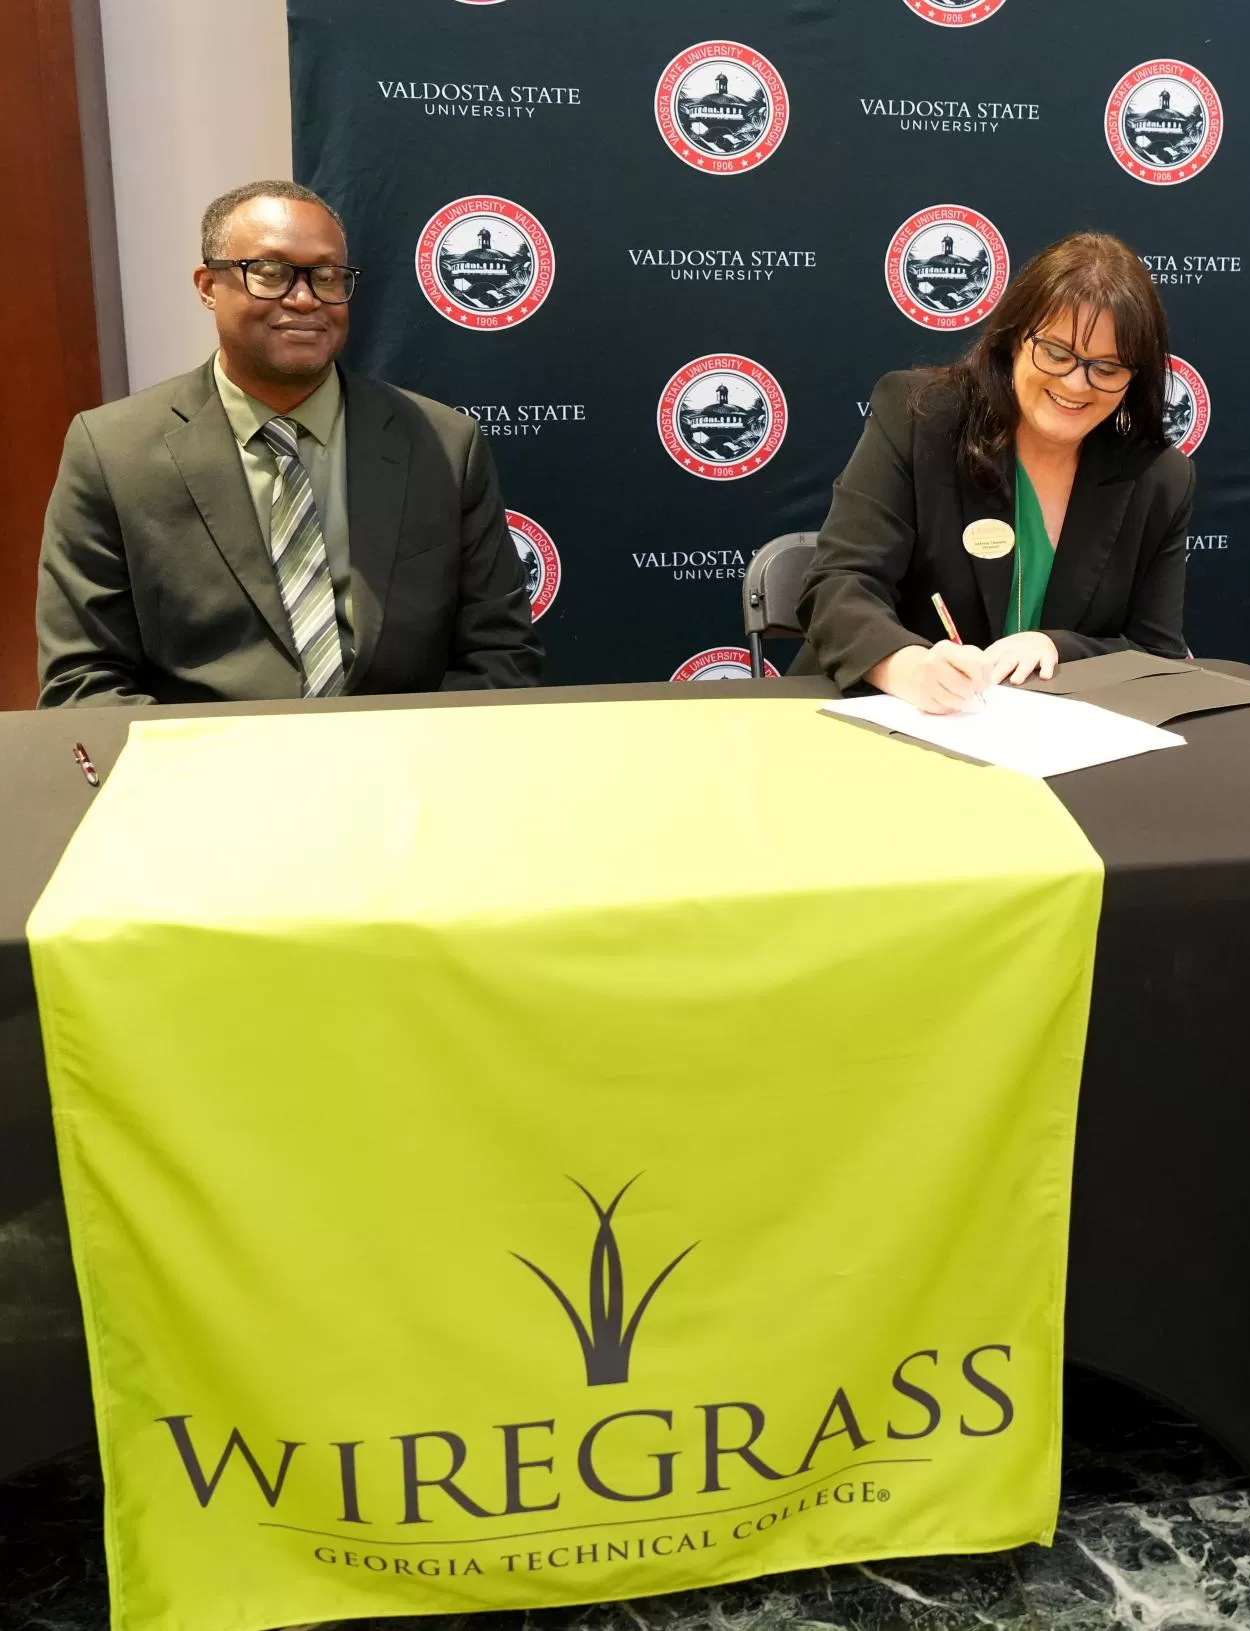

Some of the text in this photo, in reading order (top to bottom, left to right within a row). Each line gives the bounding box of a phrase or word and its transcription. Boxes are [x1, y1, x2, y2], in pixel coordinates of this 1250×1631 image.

[943, 13, 963, 22] 1906
[377, 81, 581, 104] VALDOSTA STATE
[660, 46, 785, 147] VALDOSTA STATE UNIVERSITY VALDOSTA GEORGIA
[424, 104, 535, 118] UNIVERSITY
[860, 98, 1040, 120] VALDOSTA STATE
[1108, 64, 1220, 159] VALDOSTA STATE UNIVERSITY VALDOSTA GEORGIA
[900, 119, 998, 133] UNIVERSITY
[712, 161, 734, 170] 1906
[1153, 172, 1172, 180] 1906
[421, 200, 550, 302] VALDOSTA STATE UNIVERSITY VALDOSTA GEORGIA
[628, 250, 816, 267] VALDOSTA STATE
[890, 210, 1006, 304] VALDOSTA STATE UNIVERSITY VALDOSTA GEORGIA
[1183, 256, 1240, 272] STATE
[670, 269, 774, 280] UNIVERSITY
[1150, 274, 1203, 284] ERSITY
[476, 316, 498, 326] 1906
[936, 318, 956, 327] 1906
[518, 404, 586, 421] STATE
[661, 358, 784, 455] VALDOSTA STATE UNIVERSITY VALDOSTA GEORGIA
[1180, 366, 1208, 446] VALDOSTA GEORGIA
[480, 424, 542, 436] ERSITY
[712, 467, 734, 476] 1906
[1186, 535, 1228, 550] TATE
[521, 522, 557, 606] VALDOSTA GEORGIA
[632, 550, 745, 568] VALDOSTA
[673, 568, 746, 580] UNIVERS
[690, 652, 744, 671] UNIVERSITY
[154, 1343, 1016, 1525] WIREGRASS
[314, 1546, 484, 1576] GEORGIA
[500, 1530, 717, 1572] TECHNICAL
